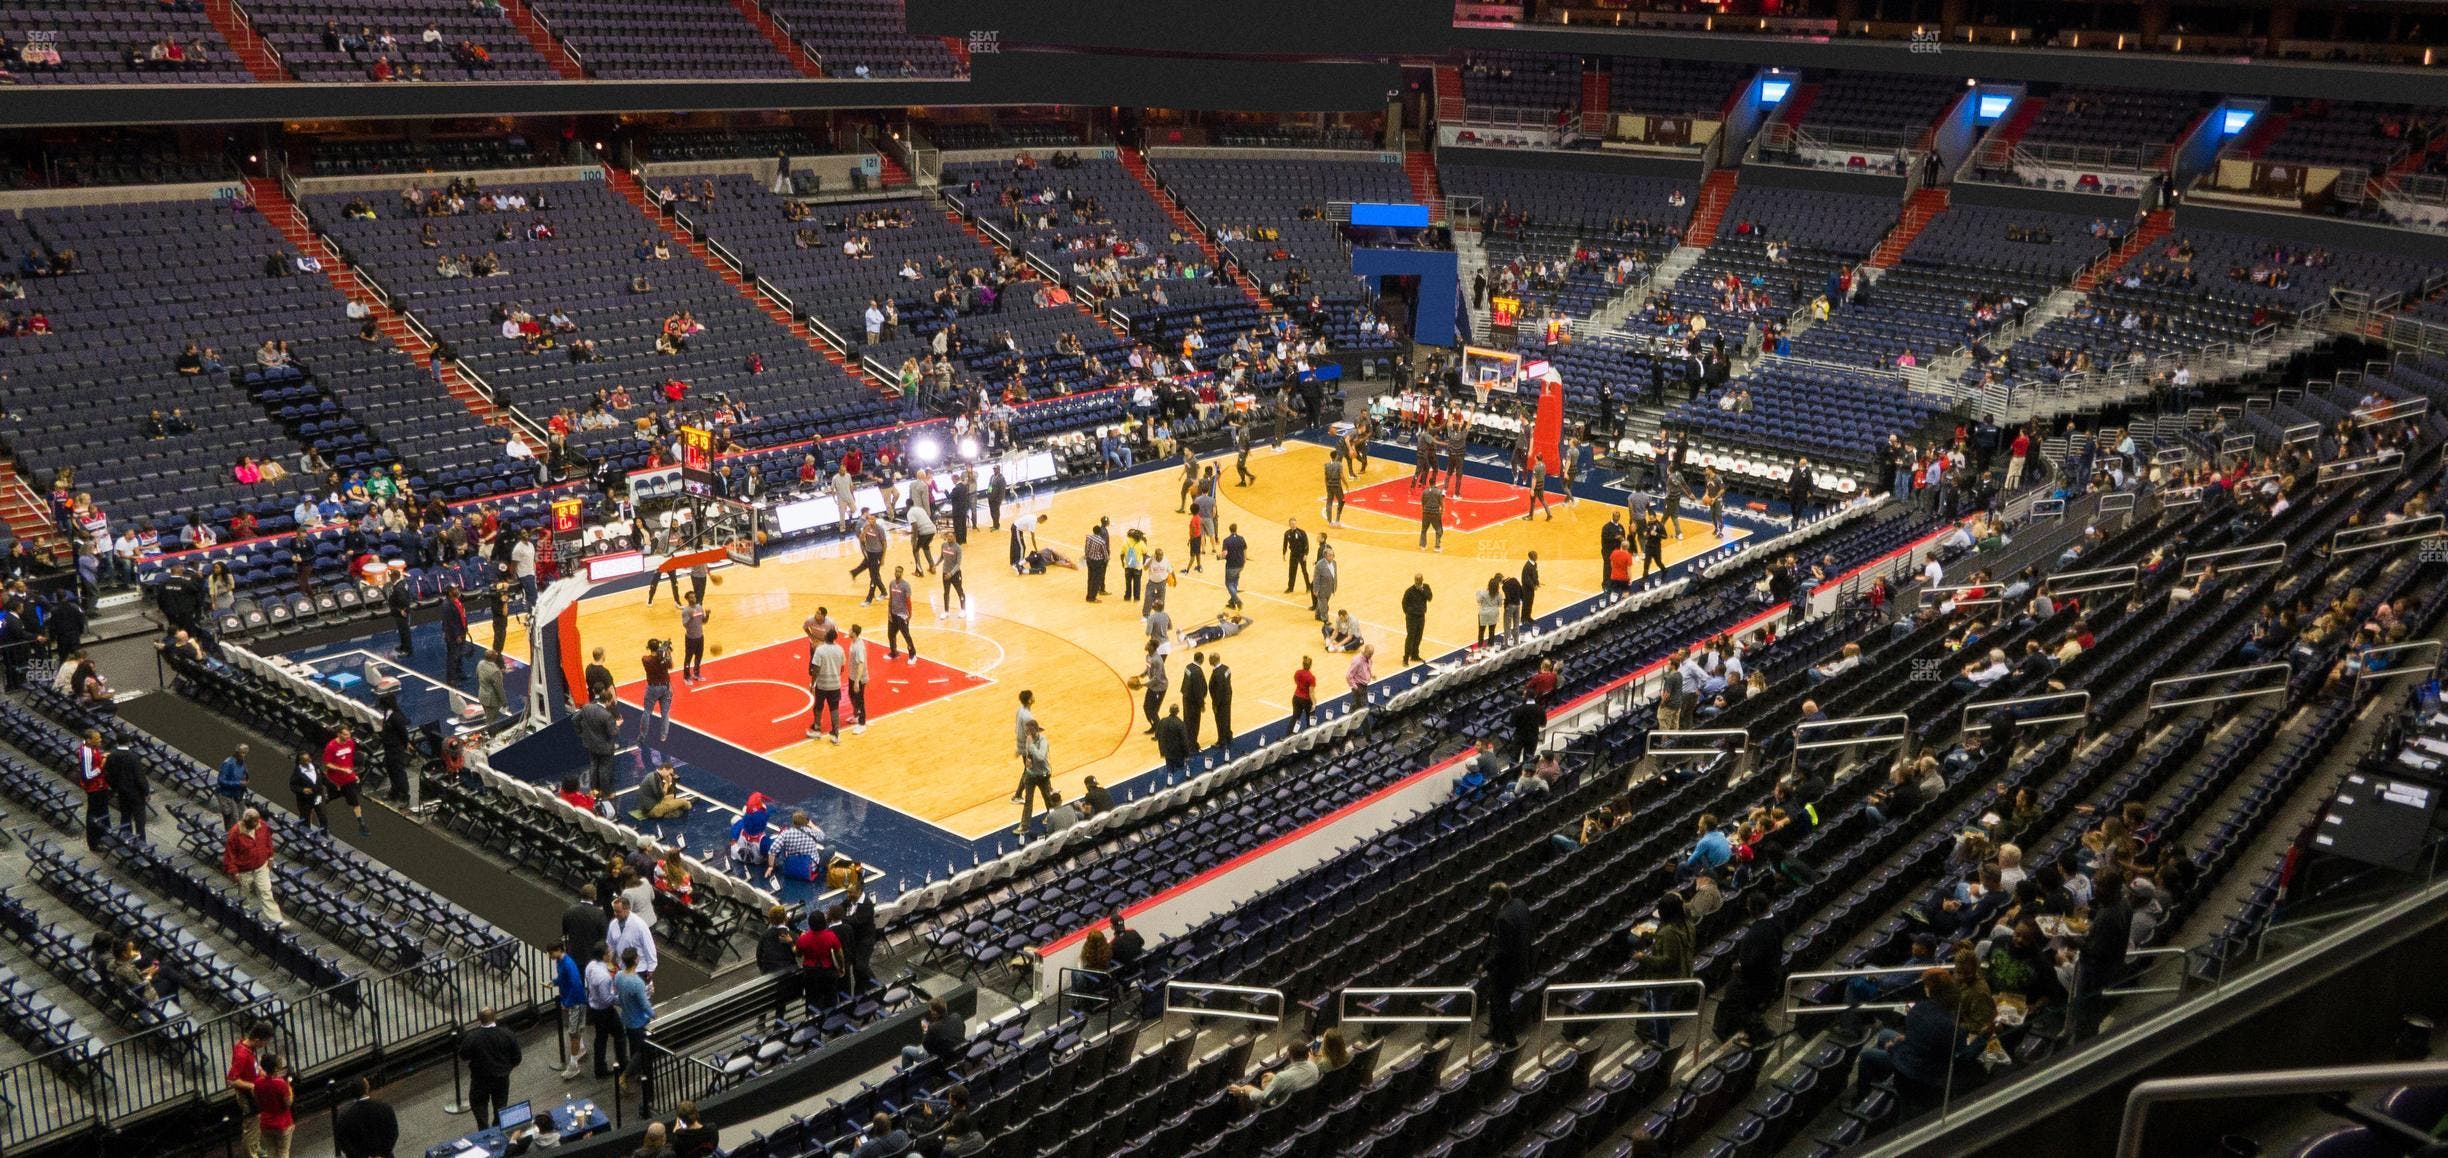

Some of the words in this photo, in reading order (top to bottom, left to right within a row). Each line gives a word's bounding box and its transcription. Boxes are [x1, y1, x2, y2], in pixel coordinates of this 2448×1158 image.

[1101, 150, 1115, 160] 120
[866, 158, 877, 168] 121
[584, 170, 602, 182] 100
